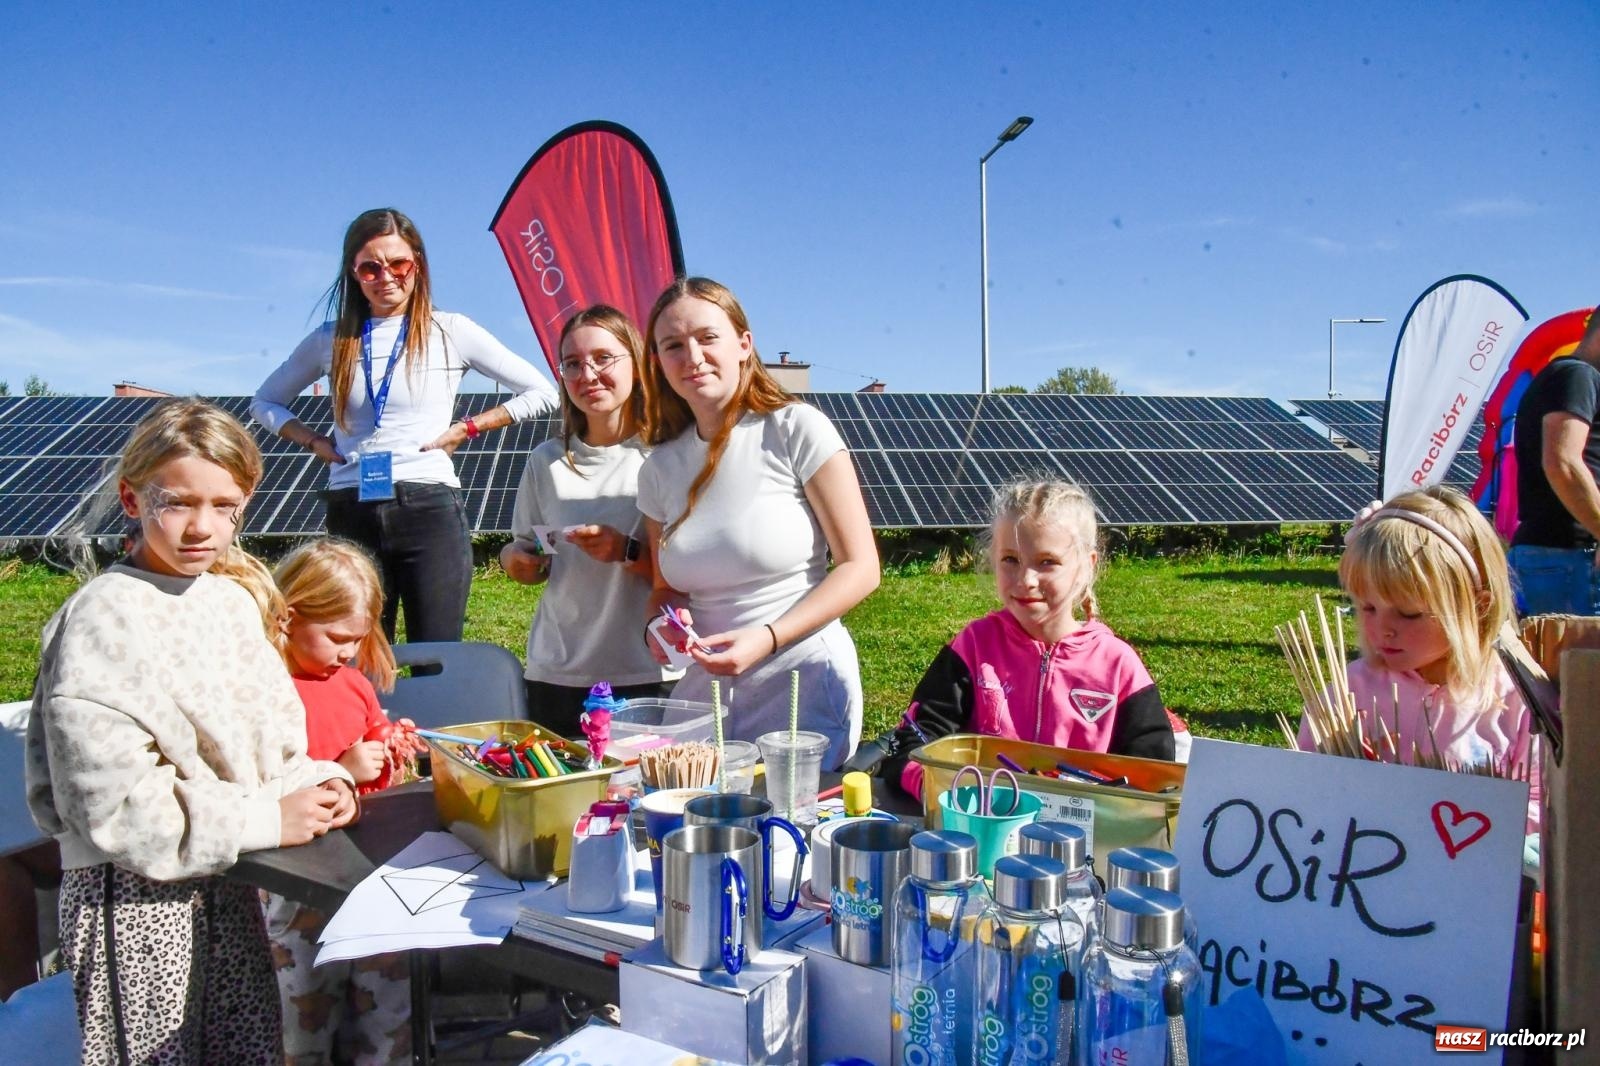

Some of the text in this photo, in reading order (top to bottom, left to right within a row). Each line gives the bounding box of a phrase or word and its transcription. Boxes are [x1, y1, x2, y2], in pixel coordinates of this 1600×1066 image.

[1411, 320, 1504, 487] Racibórz OSiR
[1203, 798, 1436, 938] OSiR
[1025, 975, 1053, 1062] Ostróg
